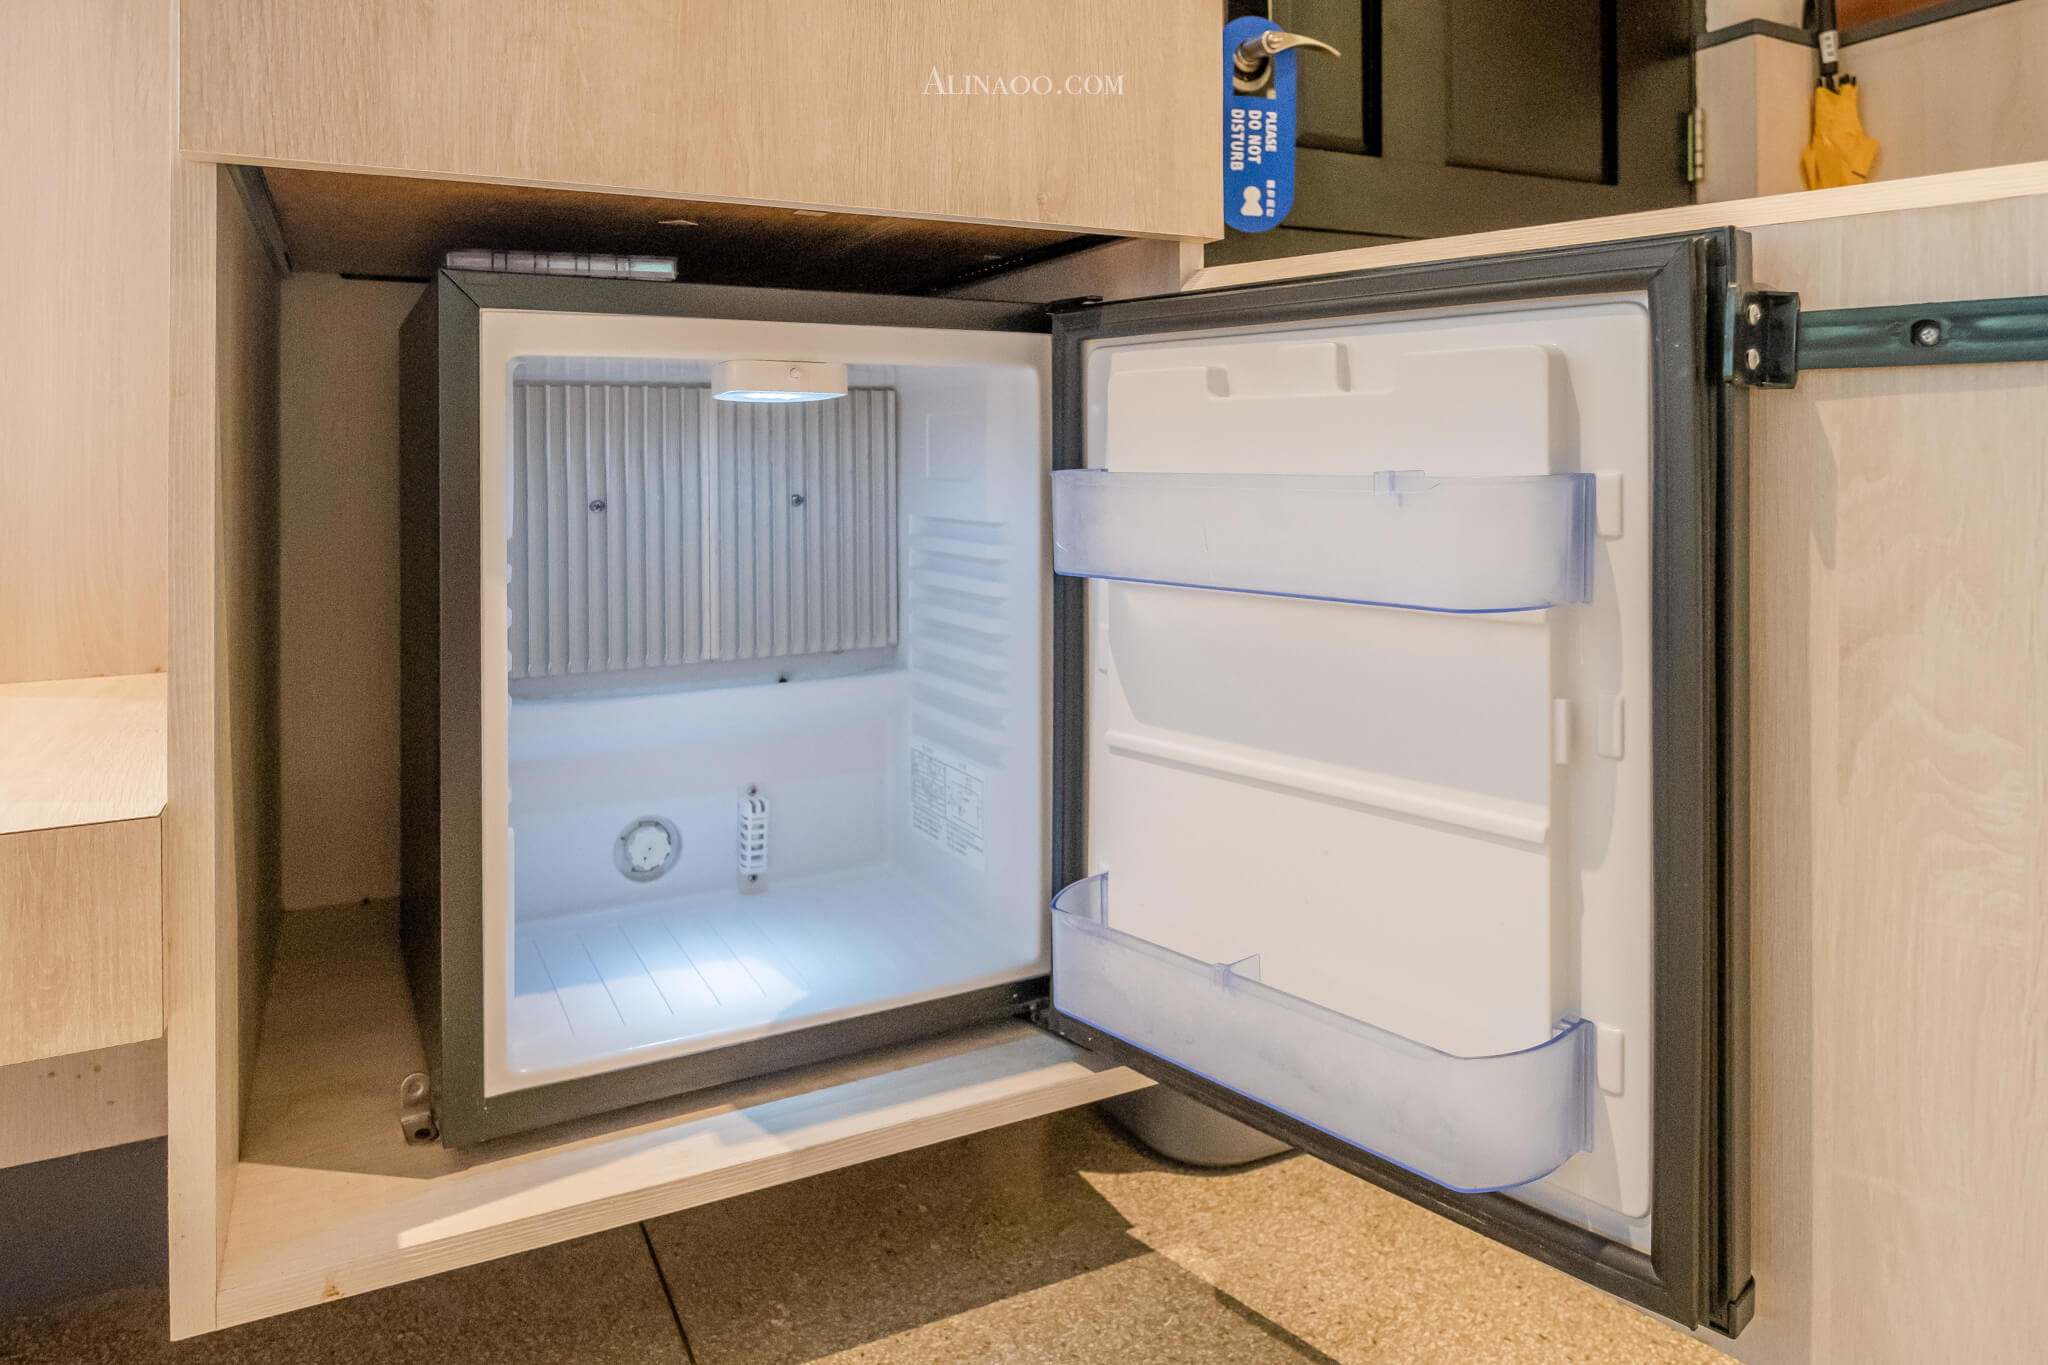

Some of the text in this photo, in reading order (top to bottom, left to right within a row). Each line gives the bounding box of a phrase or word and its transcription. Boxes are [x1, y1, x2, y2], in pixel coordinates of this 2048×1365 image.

[1230, 108, 1246, 171] DISTURB
[1247, 109, 1263, 165] DO NOT
[1265, 111, 1278, 153] PLEASE
